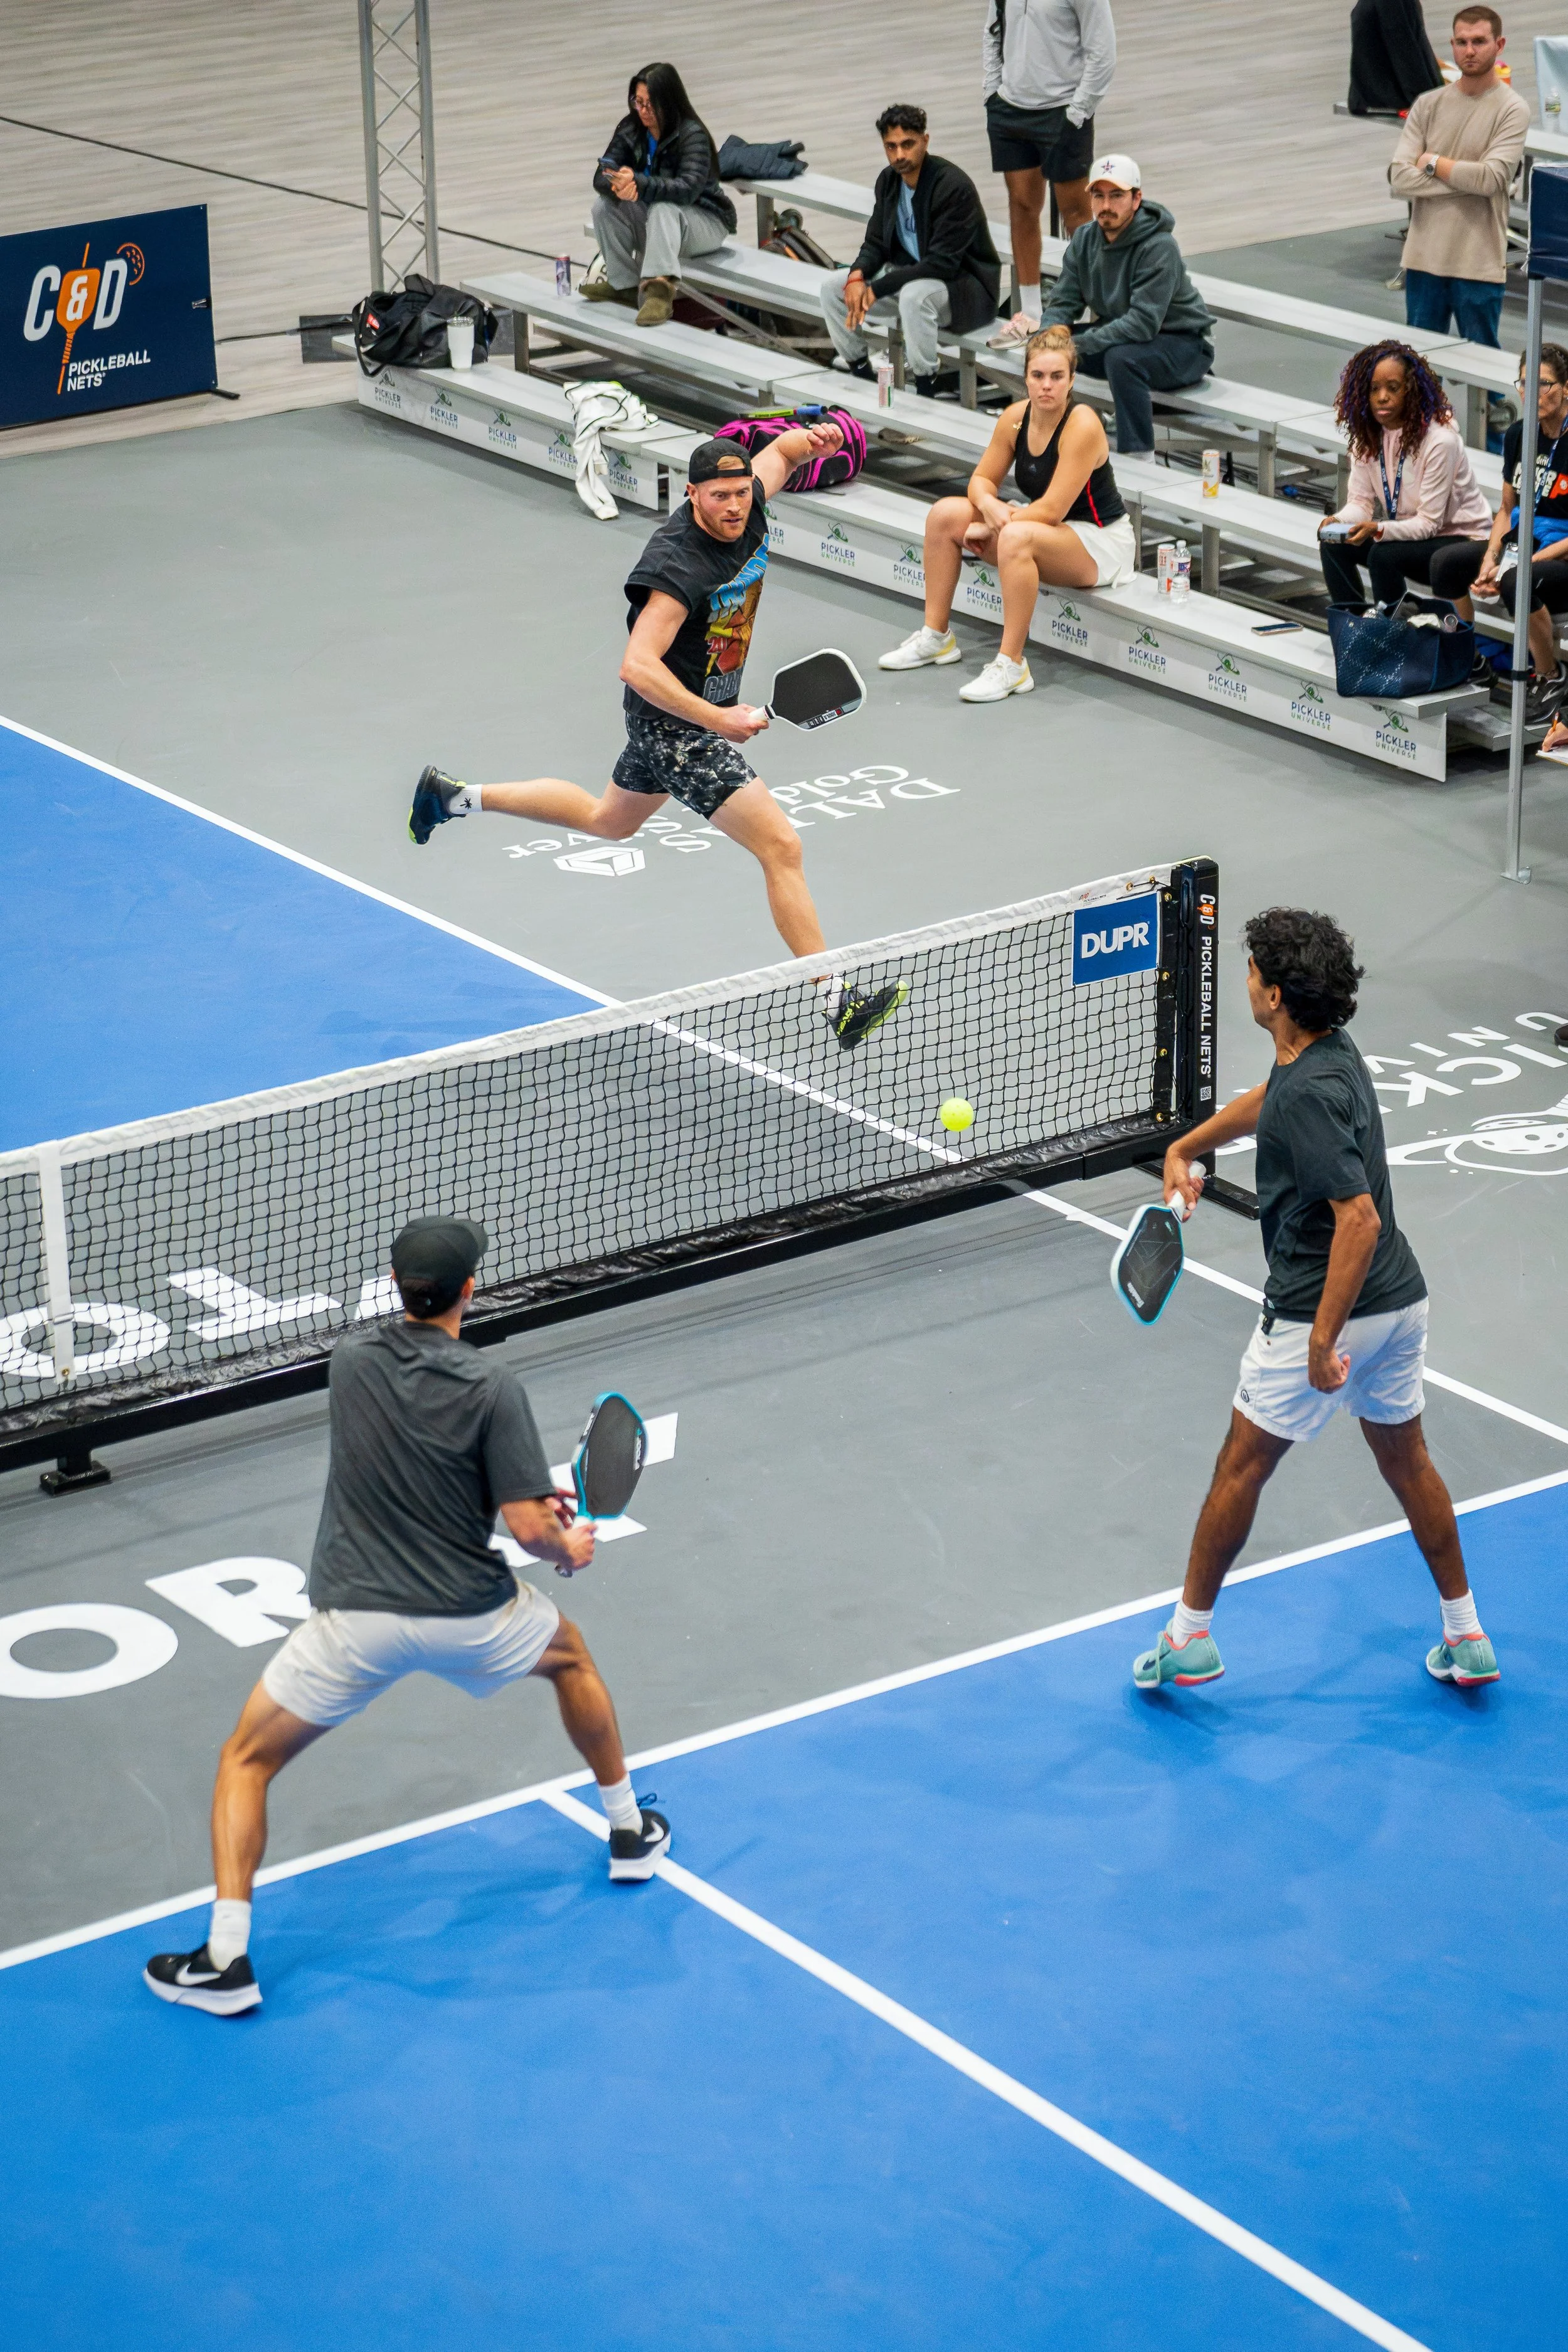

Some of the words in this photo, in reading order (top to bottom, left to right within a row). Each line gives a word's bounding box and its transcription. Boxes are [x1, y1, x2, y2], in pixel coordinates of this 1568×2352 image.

[24, 258, 127, 341] C&D
[68, 349, 151, 377] PICKLEBALL
[430, 406, 458, 421] PICKLER
[489, 426, 517, 442] PICKLER
[609, 469, 637, 485] PICKLER
[822, 542, 855, 560] PICKLER
[894, 564, 925, 581] PICKLE
[967, 587, 1002, 605] PICKLER
[1052, 620, 1088, 640] PICKLER
[1052, 631, 1088, 647] UNIVERSE
[1129, 646, 1165, 666] PICKLER
[1129, 657, 1165, 674] UNIVERSE
[1209, 674, 1247, 694] PICKLER
[1209, 684, 1247, 702] UNIVERSE
[1291, 702, 1331, 723] PICKLER
[1291, 712, 1331, 731] UNIVERSE
[1376, 731, 1416, 751] PICKLER
[1376, 741, 1416, 760] UNIVERSE
[768, 765, 909, 805] Gold
[502, 815, 682, 859] Sver
[1081, 921, 1150, 959] DUPR
[1200, 936, 1212, 1032] PICKLEBALL
